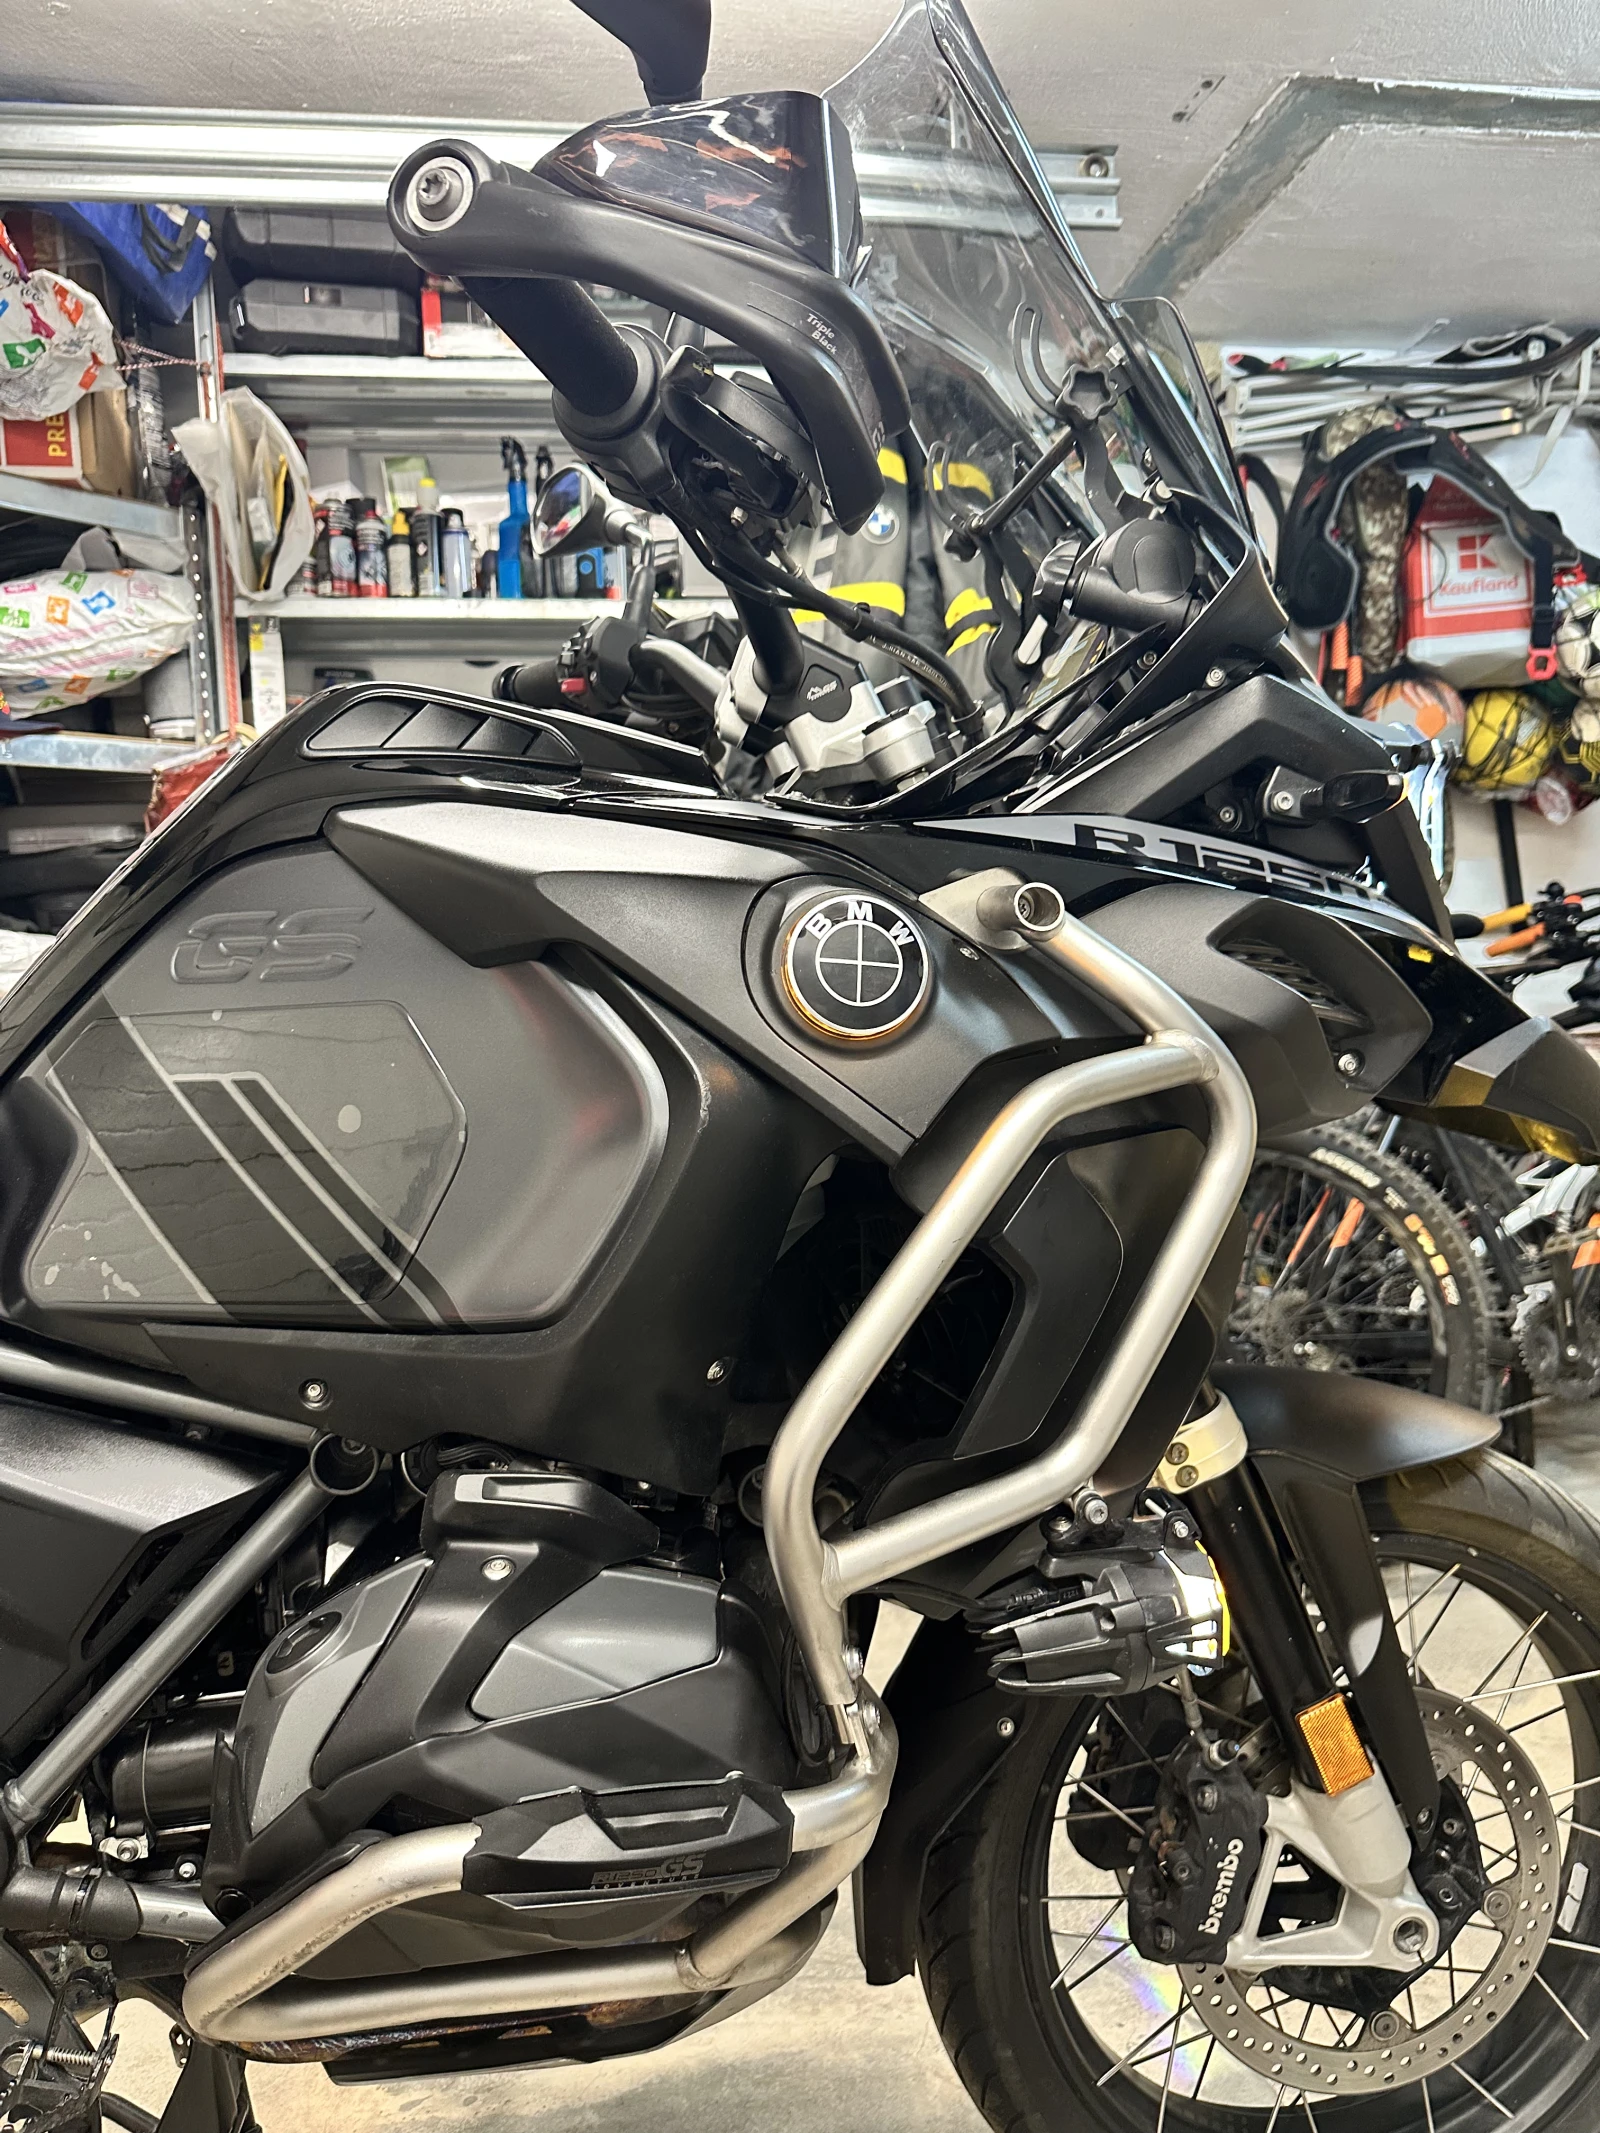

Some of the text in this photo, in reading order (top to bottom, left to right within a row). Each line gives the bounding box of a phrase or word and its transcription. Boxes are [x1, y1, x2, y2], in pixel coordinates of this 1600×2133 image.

[806, 312, 836, 340] Triple
[811, 329, 838, 355] Black
[1440, 575, 1519, 596] Kaufland
[804, 901, 915, 947] BMW
[170, 907, 375, 984] GS
[660, 1853, 707, 1878] GS
[1197, 1838, 1244, 1935] brembo
